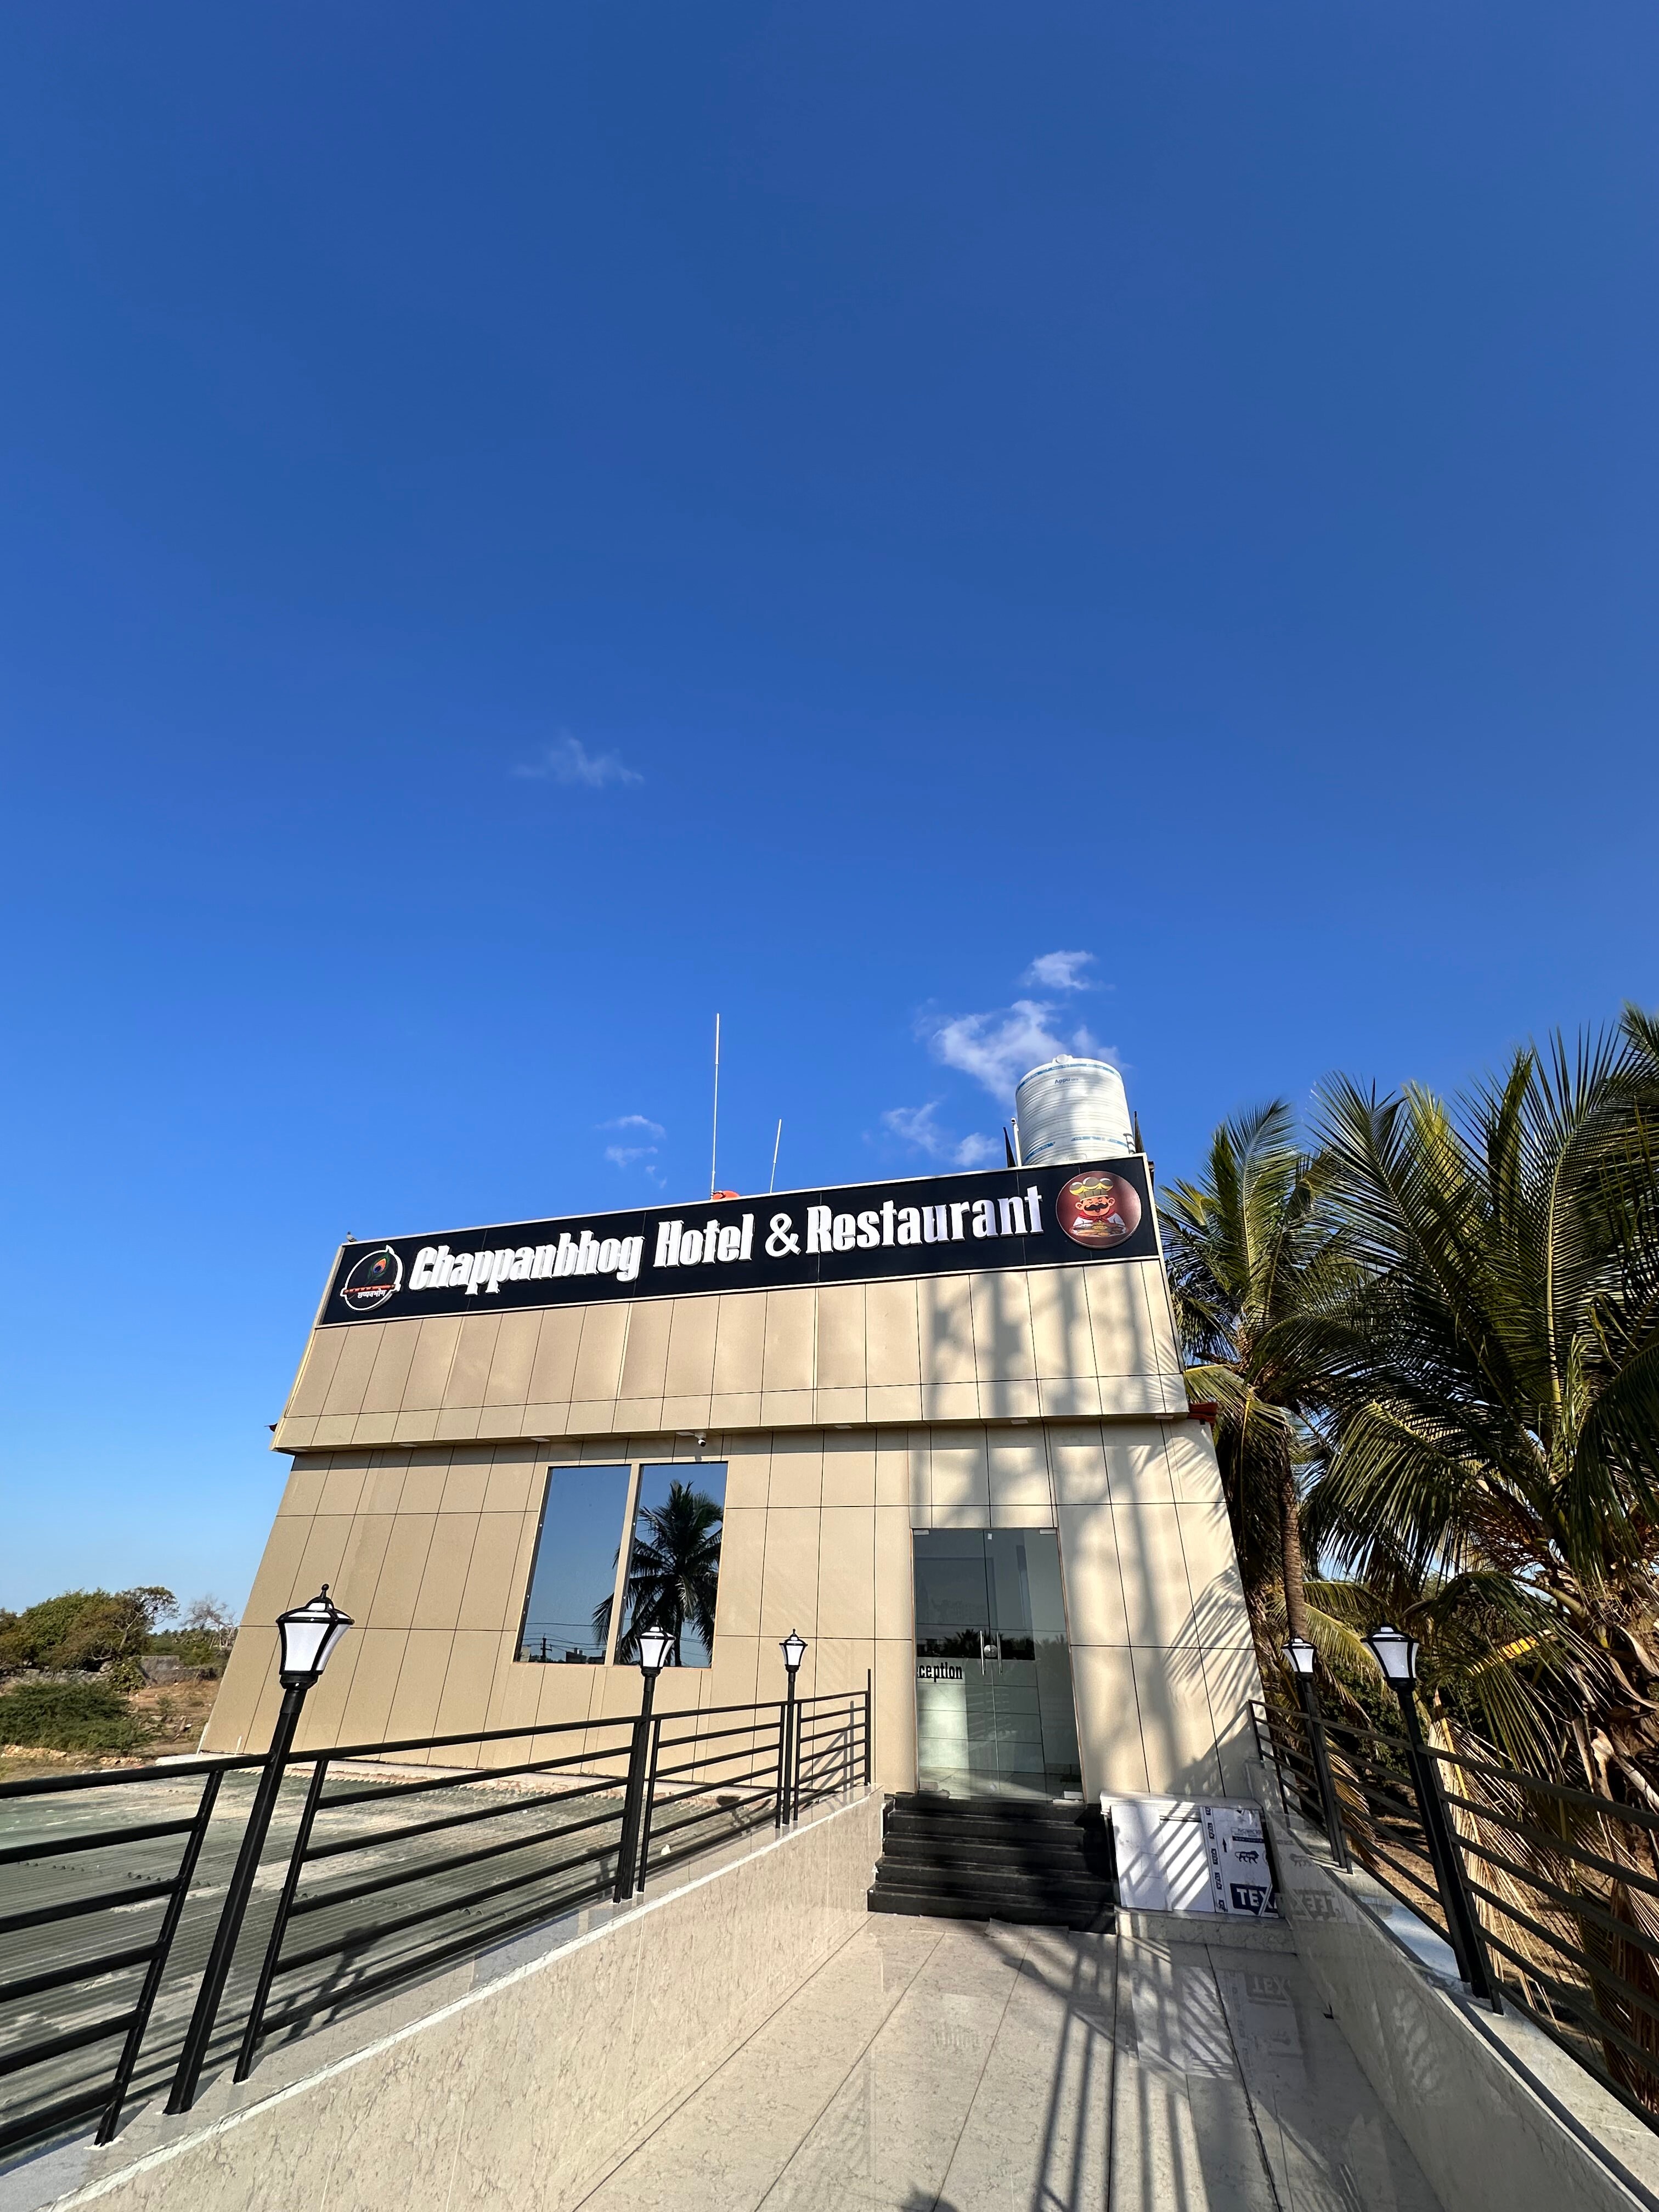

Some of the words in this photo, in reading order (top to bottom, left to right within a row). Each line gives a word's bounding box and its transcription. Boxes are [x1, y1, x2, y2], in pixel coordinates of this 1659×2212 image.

[408, 1230, 645, 1295] Chappanbhog
[653, 1213, 754, 1268] Hotel
[765, 1213, 802, 1257] &
[805, 1185, 1043, 1254] Restaurant
[917, 1661, 963, 1683] ception
